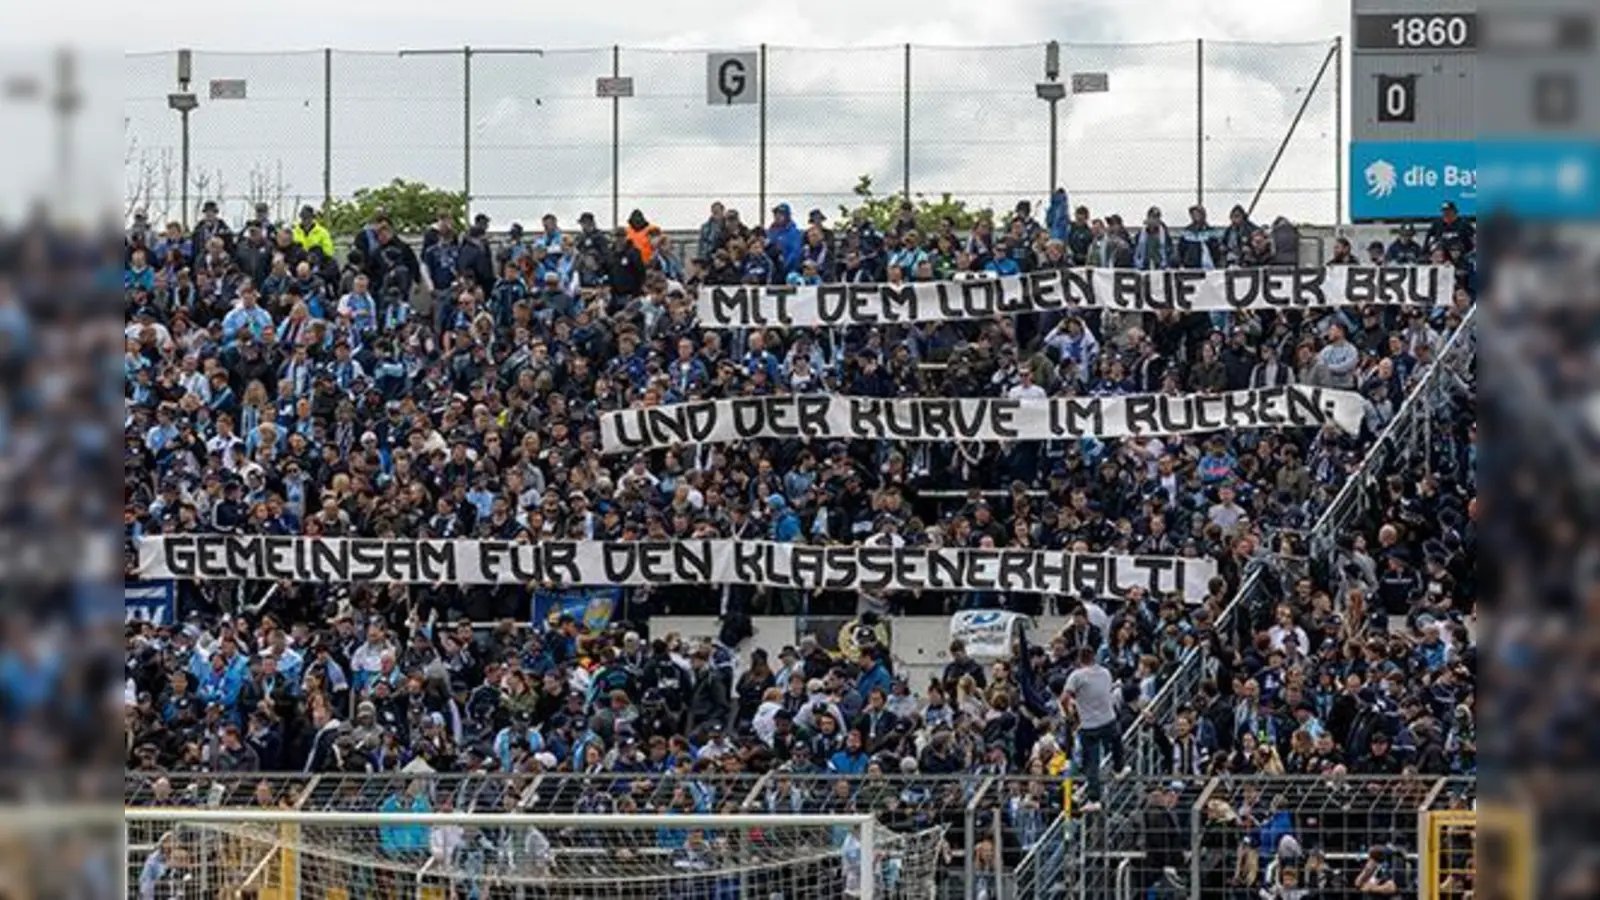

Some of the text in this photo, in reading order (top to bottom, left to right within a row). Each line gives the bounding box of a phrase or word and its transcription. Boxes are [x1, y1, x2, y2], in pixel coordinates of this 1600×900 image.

[1392, 18, 1467, 46] 1860
[718, 58, 746, 97] G
[1387, 84, 1406, 116] 0
[1403, 164, 1438, 187] die
[712, 265, 1438, 325] MIT DEM LÖWEN AUF DER BRU
[615, 400, 717, 448] UND
[732, 396, 831, 437] DER
[850, 398, 1020, 438] KURVE
[1049, 398, 1104, 436] IM
[163, 536, 457, 580] GEMEINSAM
[603, 541, 713, 582] DEN
